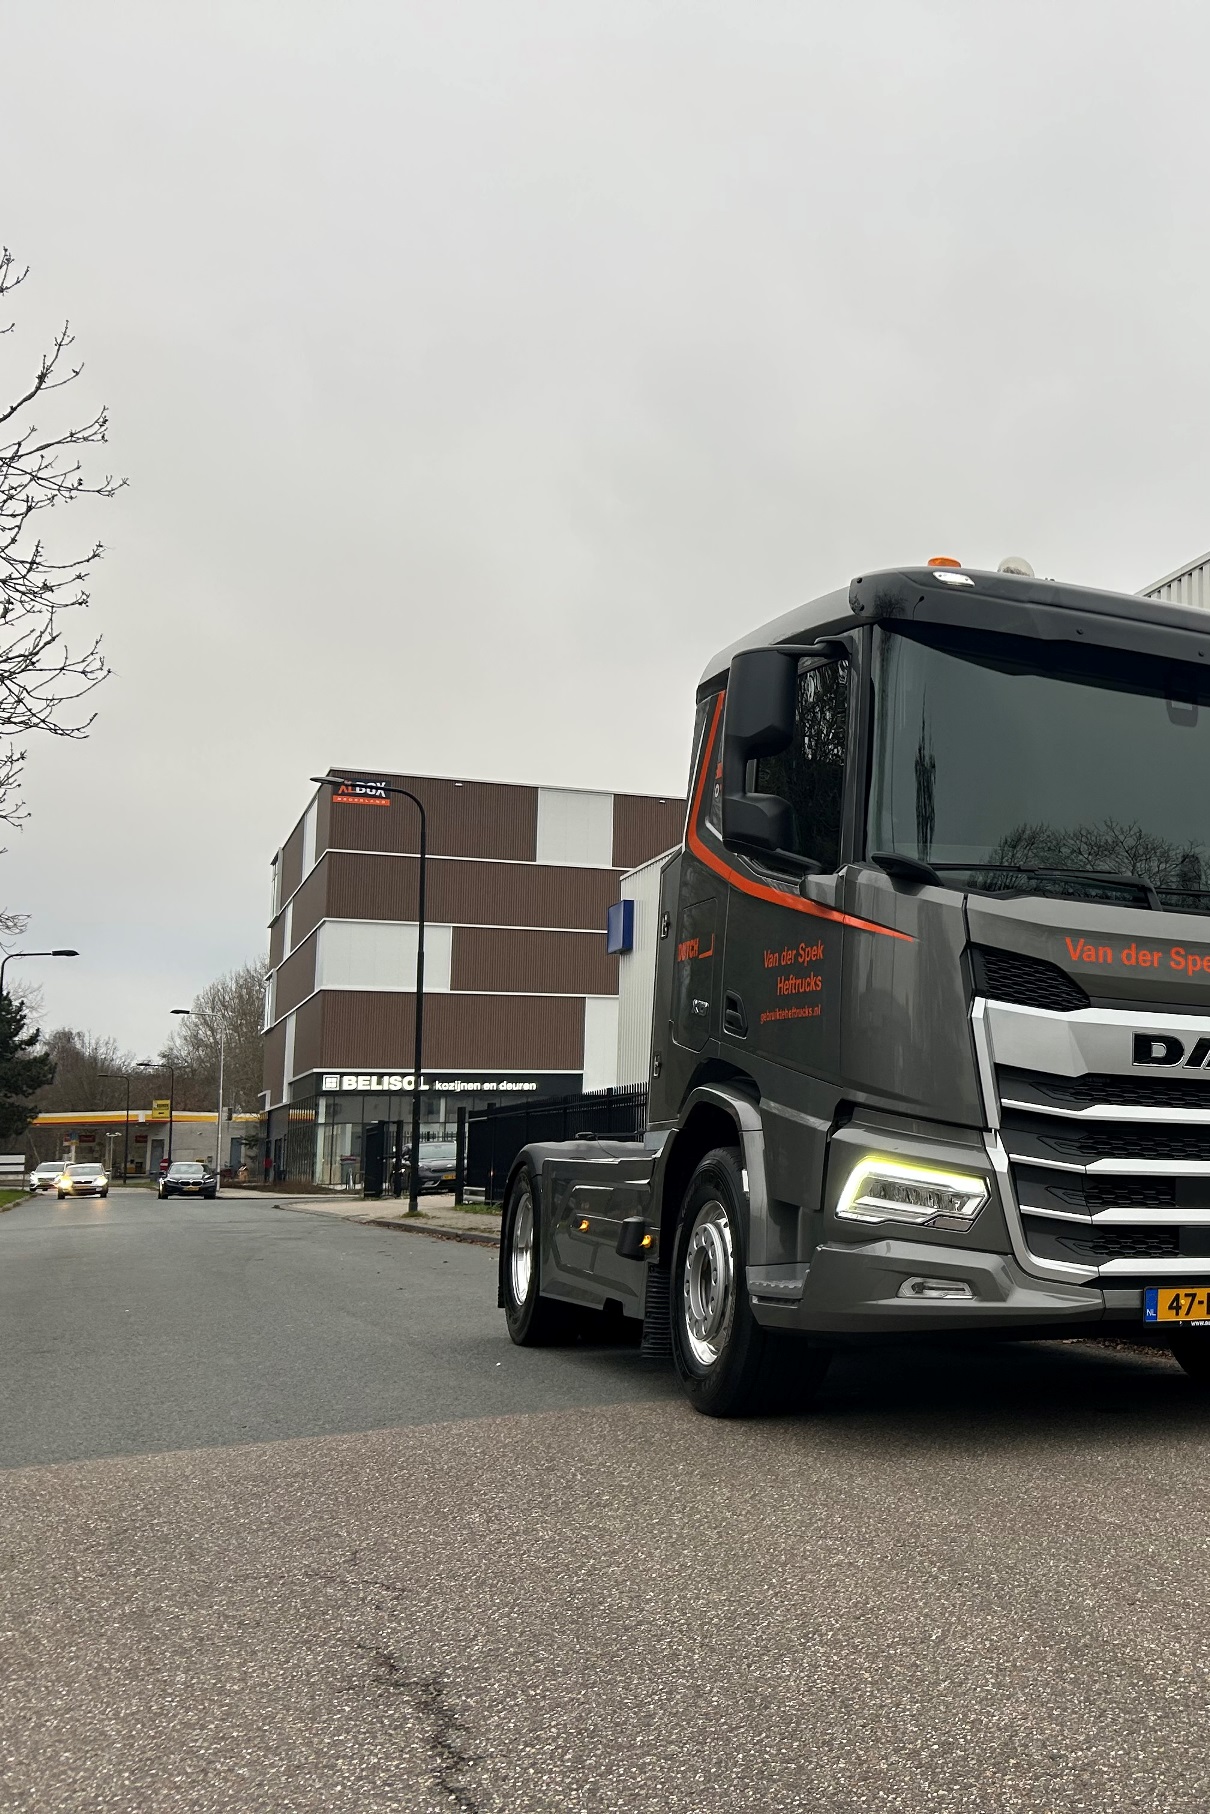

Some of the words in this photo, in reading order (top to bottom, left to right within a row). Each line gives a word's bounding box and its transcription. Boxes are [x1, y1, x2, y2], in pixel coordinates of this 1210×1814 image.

[764, 949, 779, 968] Van
[780, 946, 797, 966] der
[797, 940, 824, 966] Spek
[1065, 936, 1114, 964] Van
[1120, 942, 1163, 968] der
[777, 972, 822, 996] Heftrucks
[341, 1075, 430, 1091] BELISOL
[434, 1080, 481, 1093] kozijnen
[482, 1082, 497, 1091] en
[498, 1081, 537, 1091] deuren
